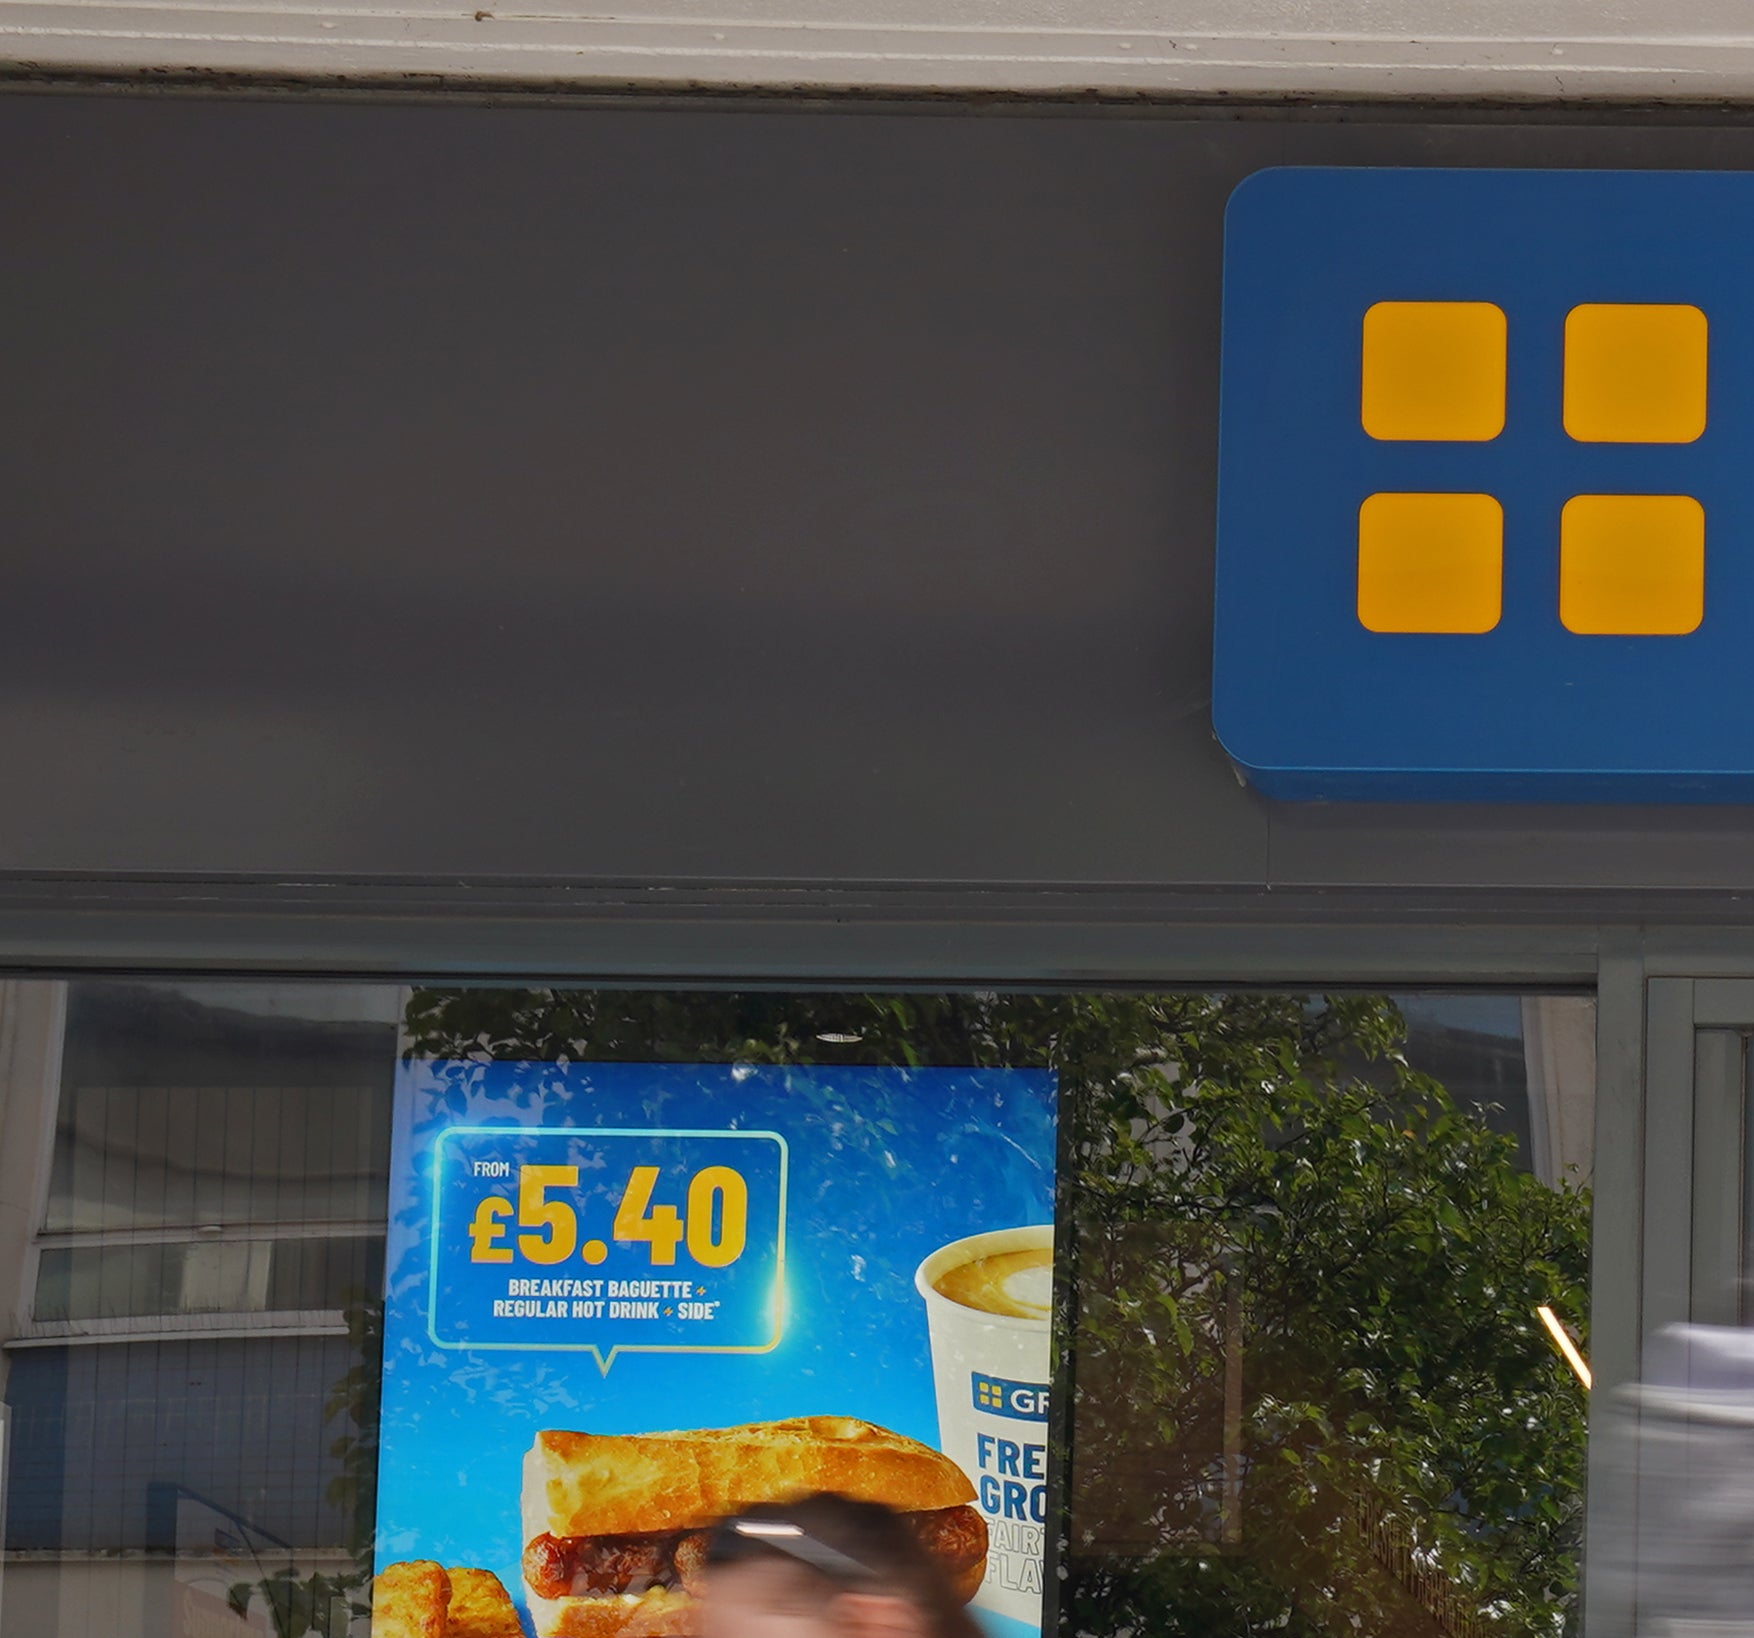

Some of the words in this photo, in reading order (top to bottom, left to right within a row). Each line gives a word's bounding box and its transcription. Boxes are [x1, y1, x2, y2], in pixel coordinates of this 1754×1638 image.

[474, 1162, 509, 1177] FROM
[469, 1164, 748, 1268] £5.40
[508, 1279, 604, 1297] BREAKFAST
[608, 1281, 692, 1298] BAGUETTE
[493, 1300, 568, 1317] REGULAR
[572, 1301, 604, 1318] HOT
[609, 1302, 659, 1319] DRINK
[987, 1517, 1045, 1556] FAIR
